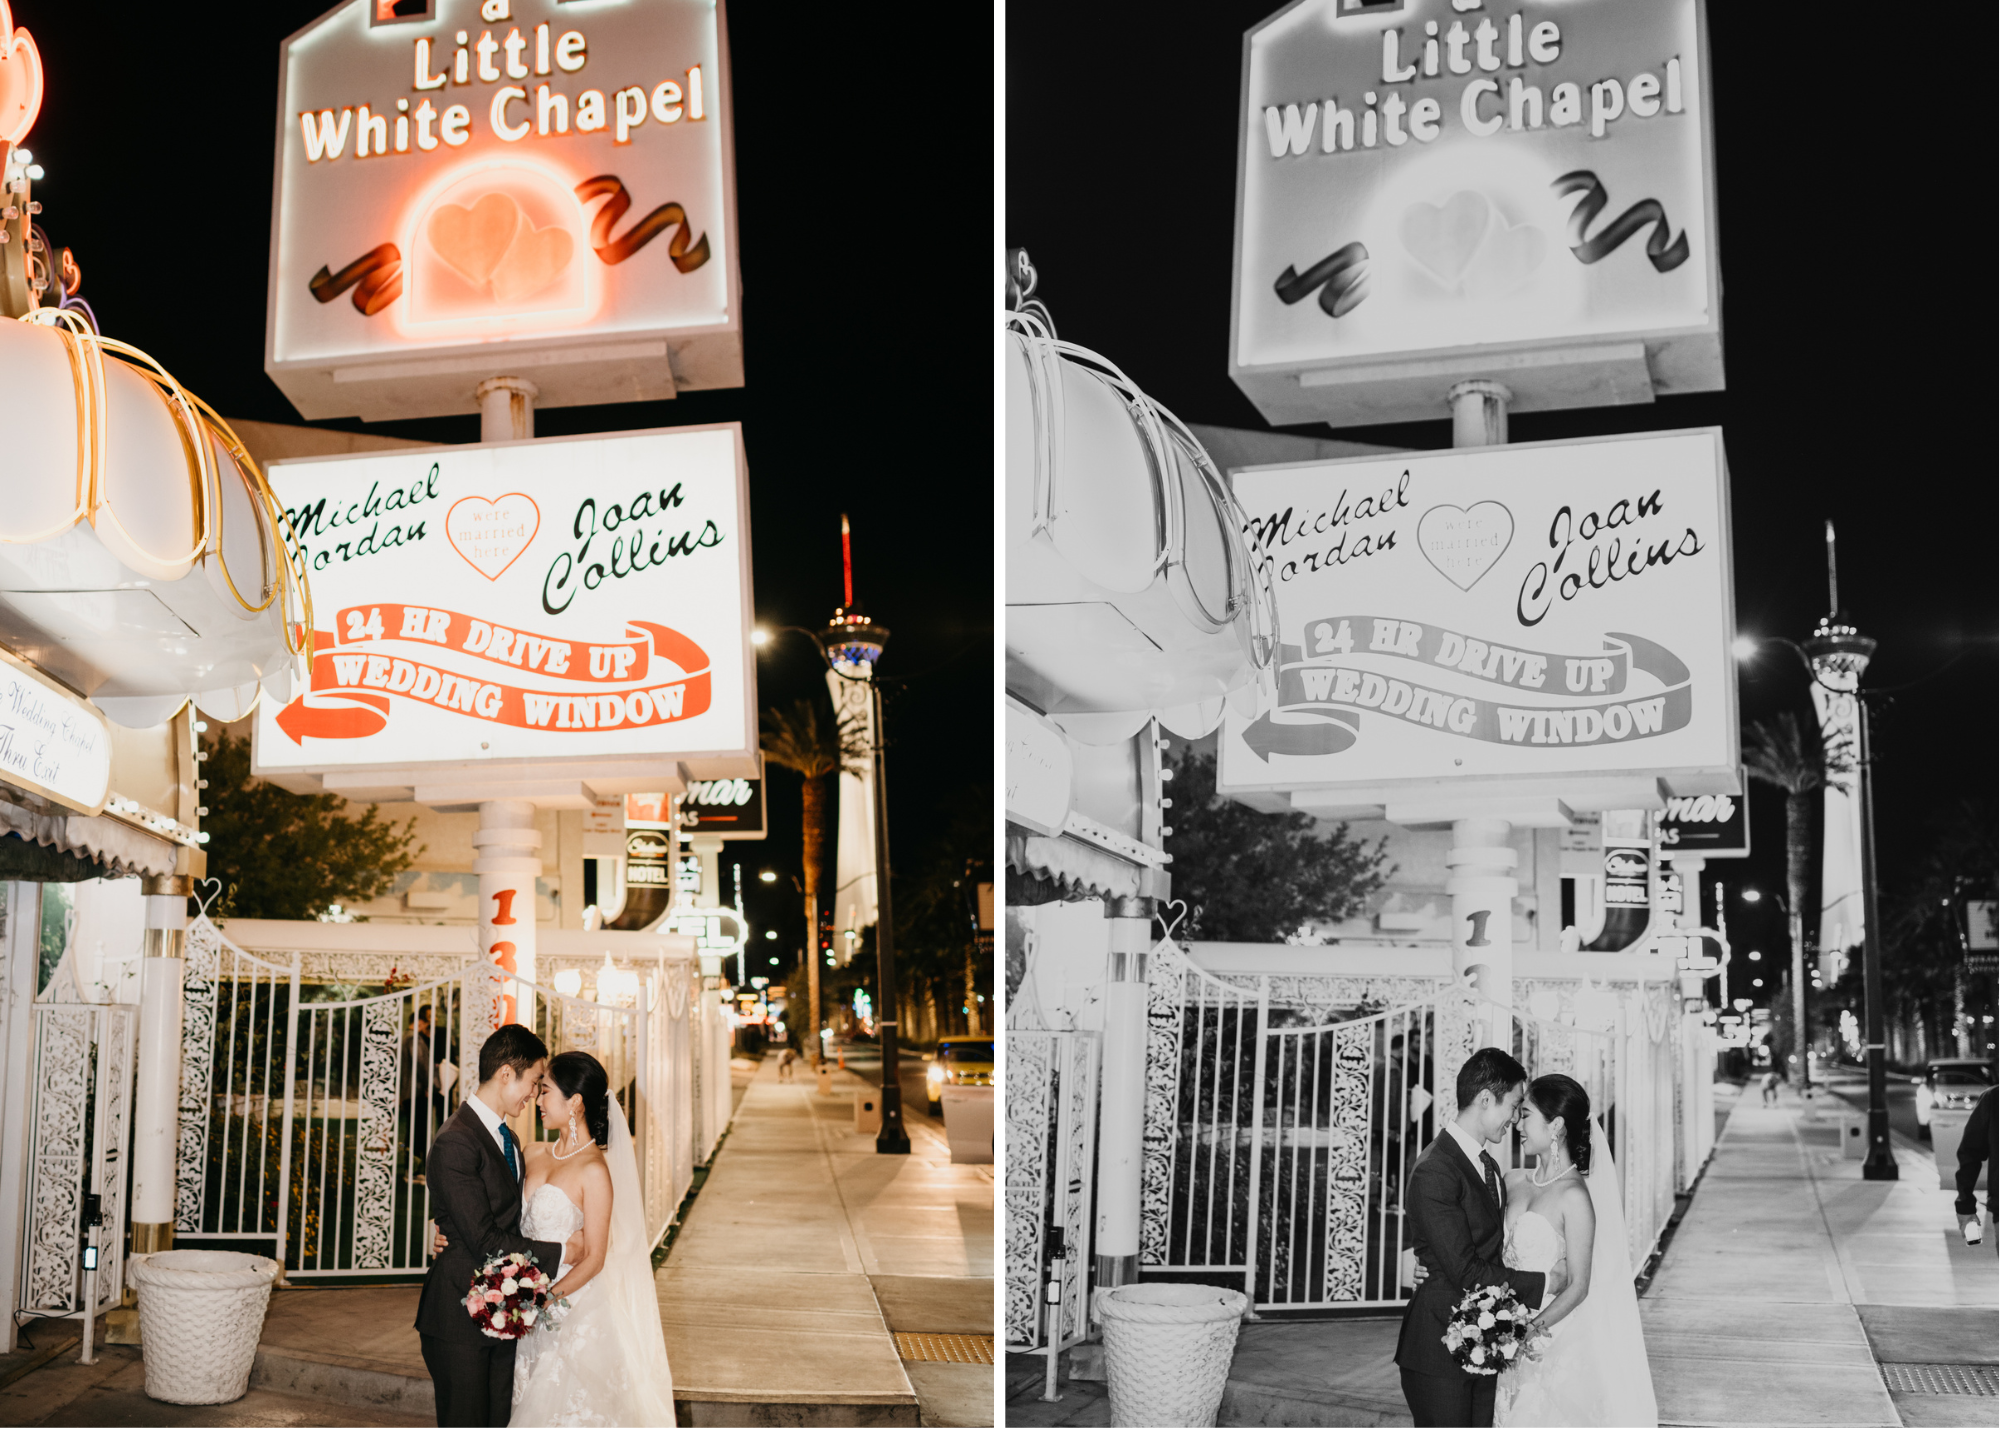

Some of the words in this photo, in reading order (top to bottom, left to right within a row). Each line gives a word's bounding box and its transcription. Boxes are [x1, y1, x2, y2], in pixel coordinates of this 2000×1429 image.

[412, 21, 588, 91] Little
[1380, 13, 1562, 85] Little
[299, 97, 471, 163] White
[489, 63, 706, 147] Chapel
[1263, 91, 1442, 158] White
[1459, 54, 1686, 140] Chapel
[277, 461, 440, 542] Michael
[459, 523, 525, 541] married
[473, 510, 509, 522] were
[573, 482, 687, 565] Joan
[1242, 469, 1410, 552] Michael
[1549, 489, 1665, 574] Joan
[474, 545, 509, 559] here
[542, 519, 727, 616] Collins
[1516, 528, 1707, 628] Collins
[346, 607, 385, 642] 24
[399, 606, 451, 644] HR
[463, 620, 571, 675] DRIVE
[588, 645, 638, 680] UP
[1313, 620, 1355, 654] 24
[1372, 618, 1422, 657] HR
[1434, 632, 1548, 689] DRIVE
[1564, 658, 1616, 694] UP
[8, 681, 57, 744] Wedding
[61, 710, 97, 757] Chapel
[332, 654, 503, 720] WEDDING
[523, 684, 686, 729] WINDOW
[1300, 668, 1477, 734] WEDDING
[1497, 697, 1666, 744] WINDOW
[0, 724, 28, 771] Thru
[33, 739, 60, 784] Exit
